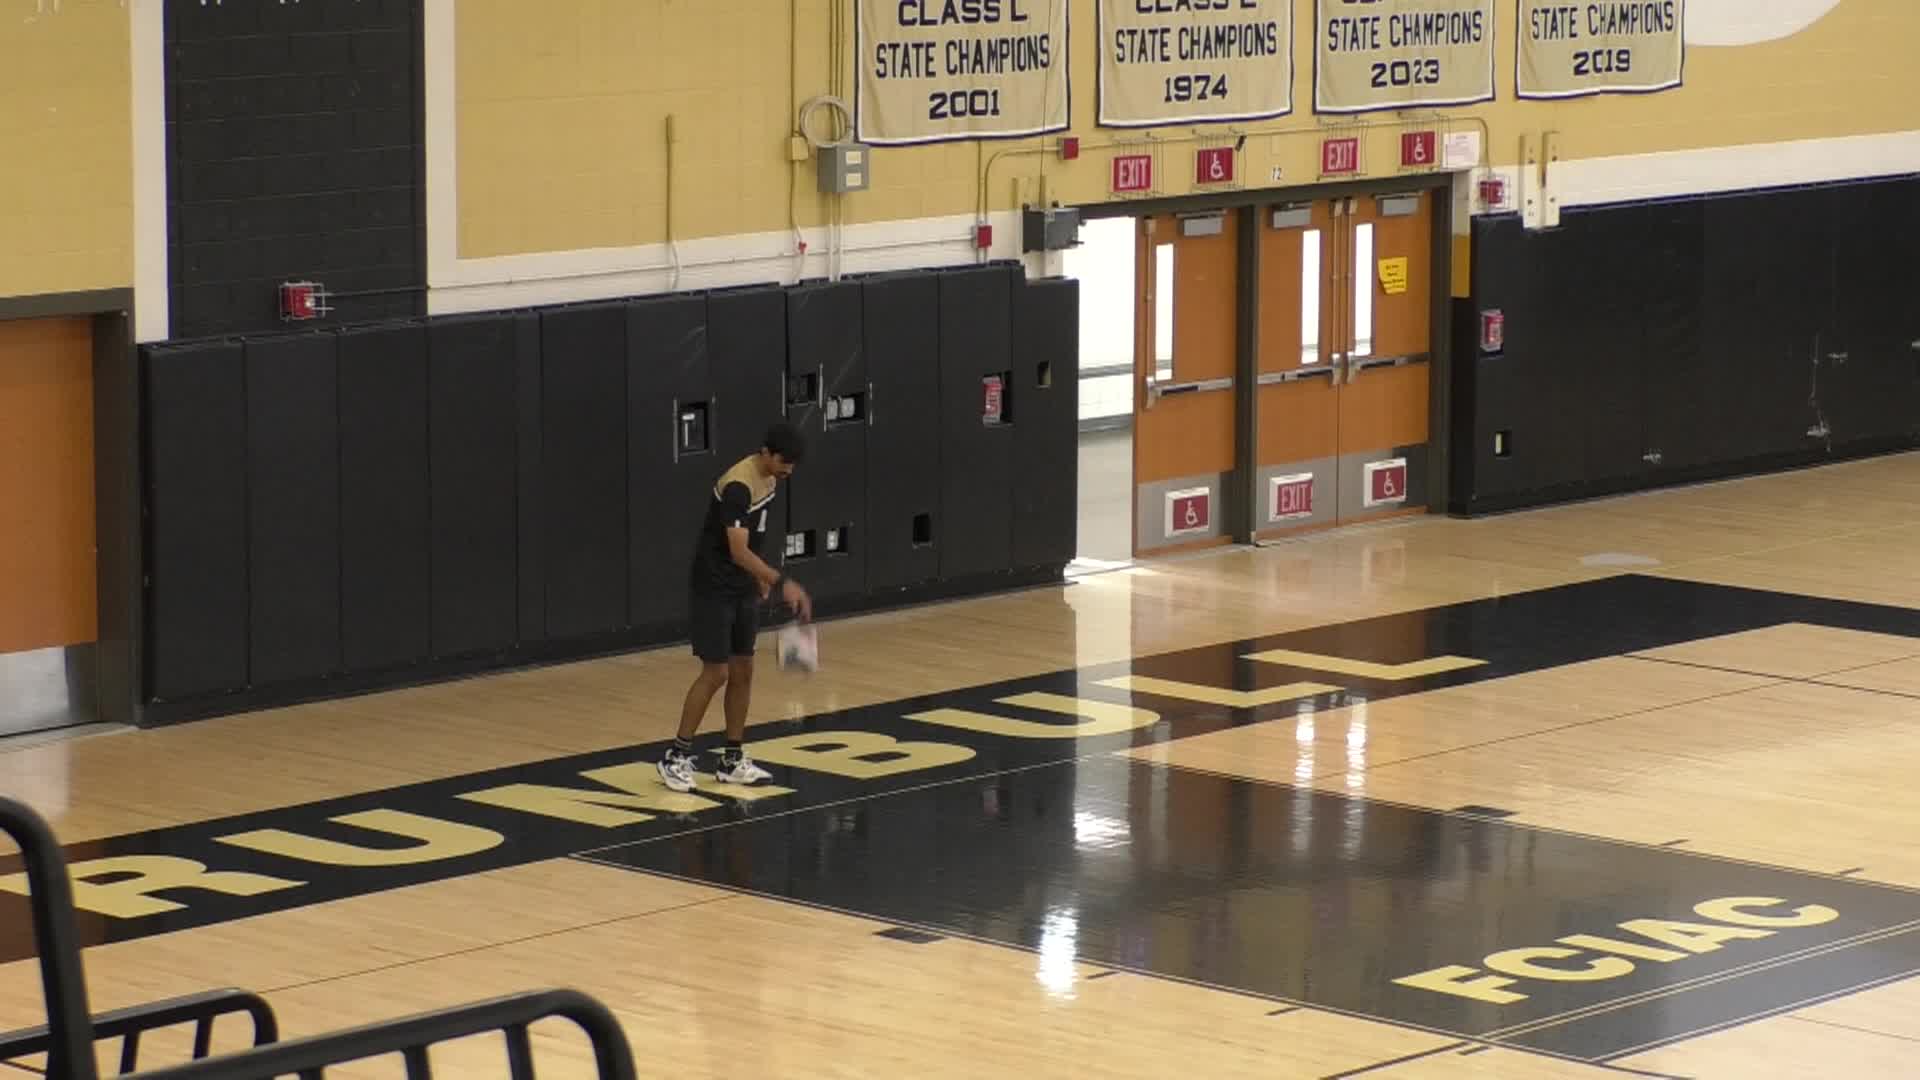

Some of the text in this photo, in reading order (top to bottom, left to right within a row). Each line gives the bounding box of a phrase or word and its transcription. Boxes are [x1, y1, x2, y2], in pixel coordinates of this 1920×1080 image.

[898, 0, 1028, 26] CLASS L
[1531, 0, 1674, 40] STATE CHAMPIONS
[1115, 22, 1277, 65] STATE CHAMPIONS
[1327, 10, 1482, 52] STATE CHAMPIONS
[875, 33, 1051, 79] STATE CHAMPIONS
[1572, 48, 1631, 76] 2019
[1164, 74, 1228, 103] 1974
[1370, 59, 1440, 88] 2023
[928, 89, 1000, 120] 2001
[1328, 142, 1356, 171] EXIT
[1118, 160, 1148, 188] EXIT
[1281, 483, 1309, 513] EXIT
[1391, 896, 1841, 1005] FCIAC
